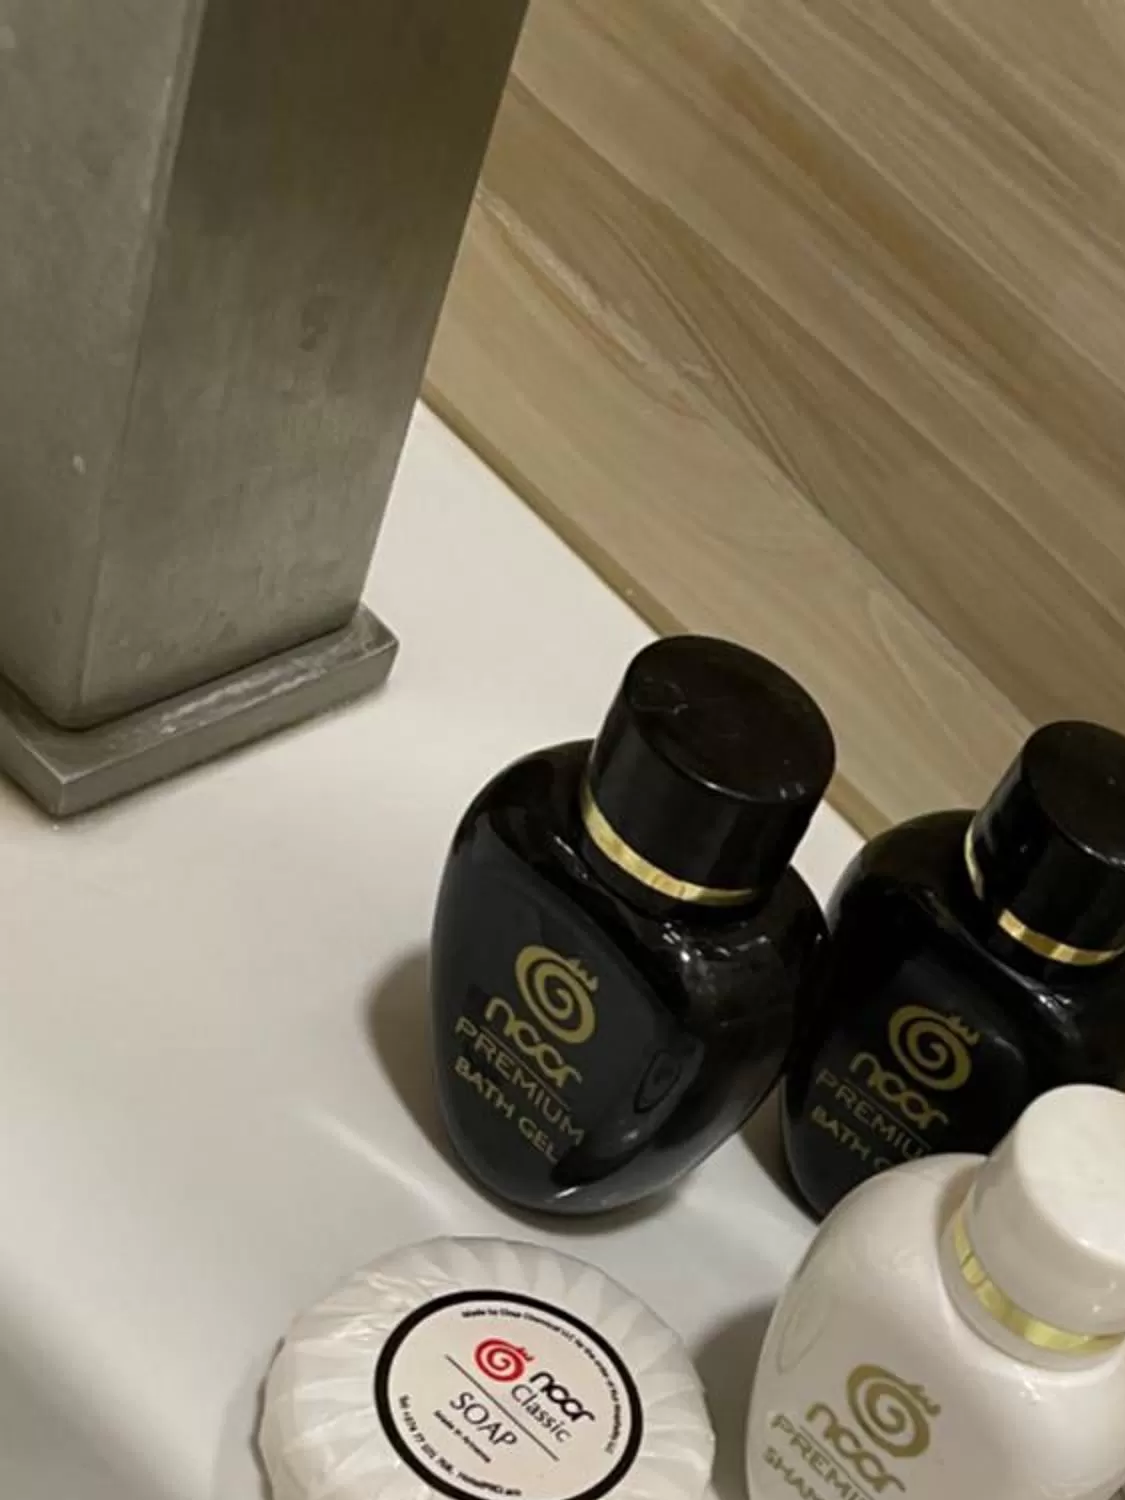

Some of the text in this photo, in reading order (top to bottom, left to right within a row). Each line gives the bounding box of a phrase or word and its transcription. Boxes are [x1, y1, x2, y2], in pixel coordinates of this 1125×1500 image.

[454, 1056, 559, 1165] BATH GEL
[455, 1015, 585, 1146] PREMIUM
[811, 1105, 871, 1160] BATH
[816, 1068, 924, 1159] PREMIU
[449, 1391, 518, 1446] SOAP
[510, 1383, 573, 1443] Classic
[529, 1371, 595, 1423] noor
